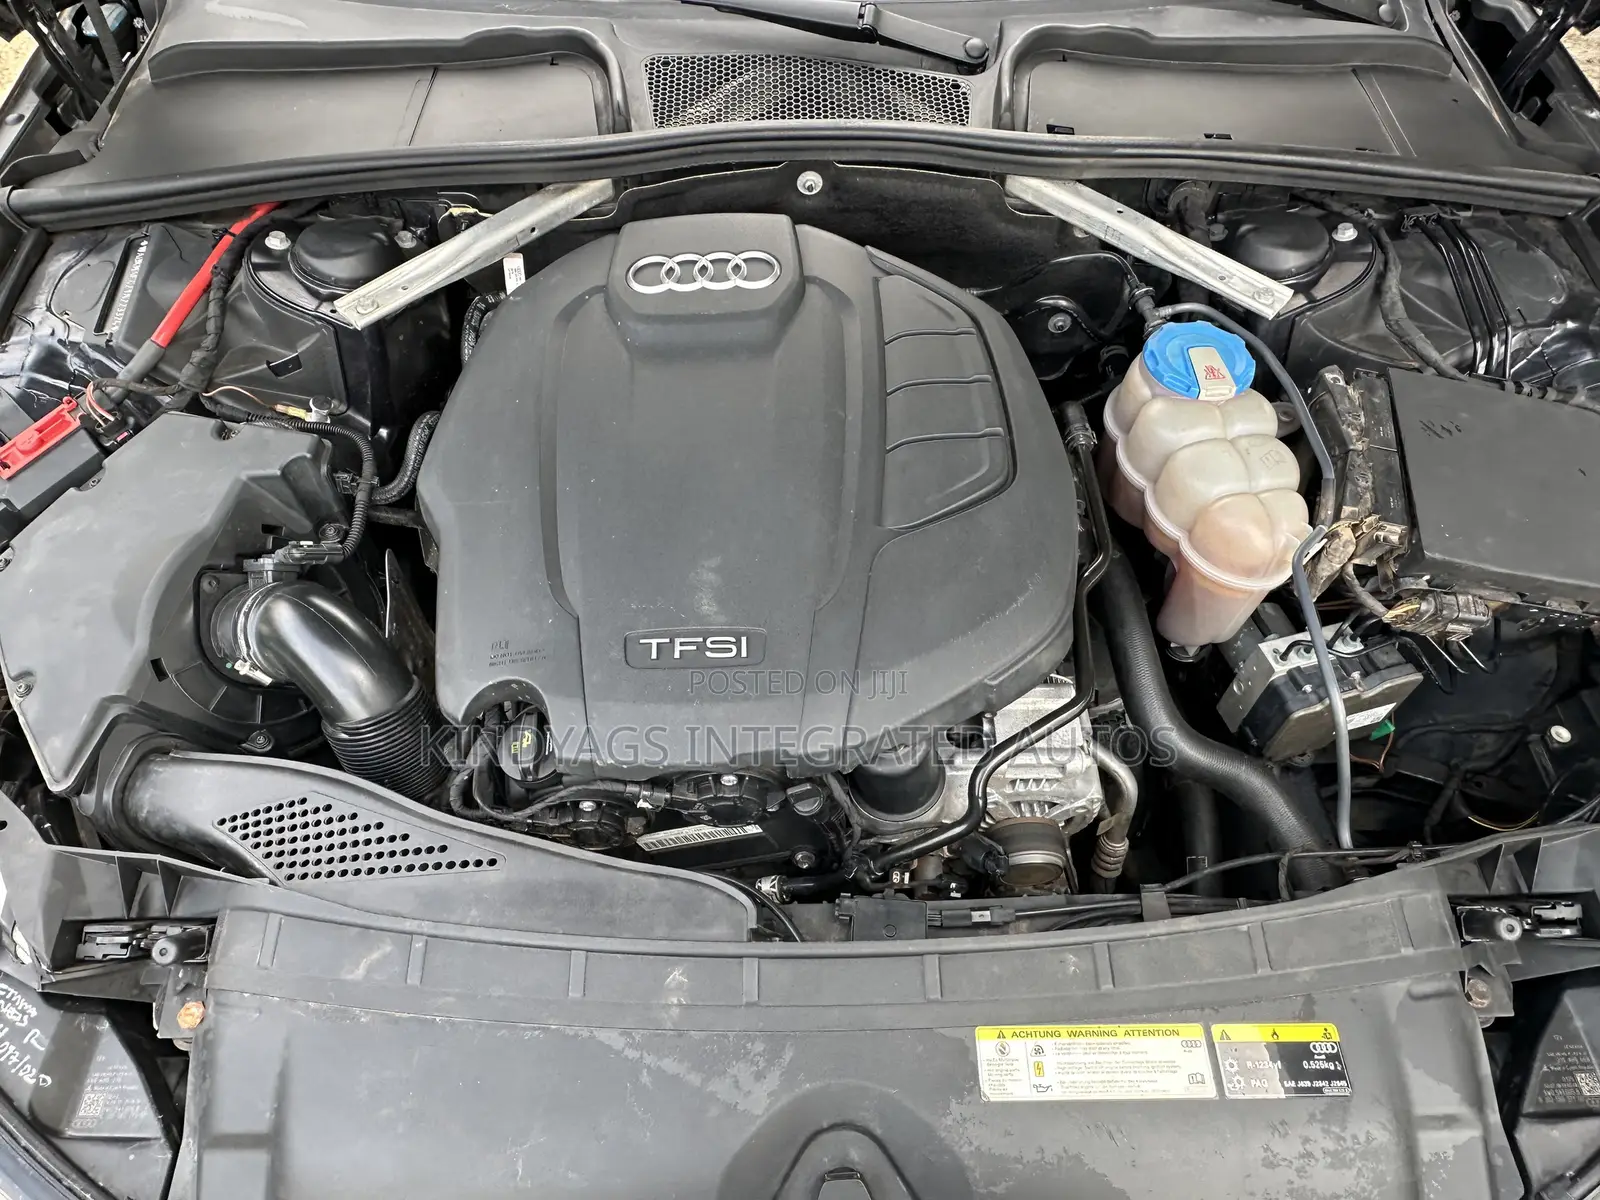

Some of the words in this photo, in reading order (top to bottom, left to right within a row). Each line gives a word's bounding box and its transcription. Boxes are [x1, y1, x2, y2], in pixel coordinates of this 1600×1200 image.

[639, 636, 748, 660] TFSI
[1011, 1029, 1062, 1039] ACHTUNG
[1066, 1029, 1118, 1038] WARNING
[1123, 1028, 1181, 1038] ATTENTION
